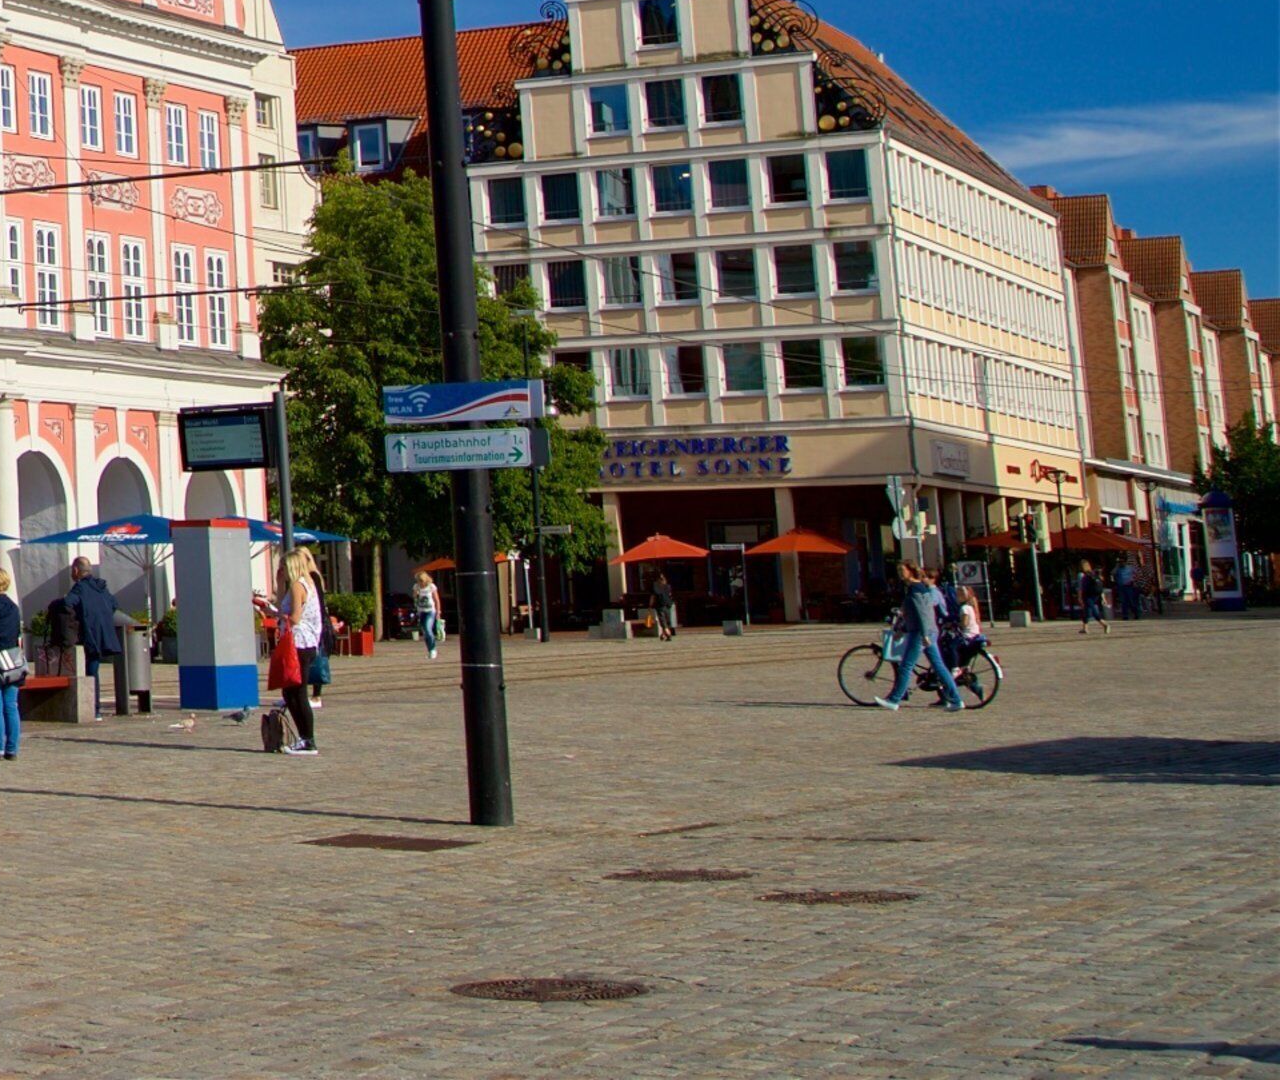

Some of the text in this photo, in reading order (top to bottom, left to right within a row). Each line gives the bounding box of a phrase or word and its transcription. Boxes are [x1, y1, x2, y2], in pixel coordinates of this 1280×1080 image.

[389, 406, 413, 415] WLAN
[412, 435, 492, 452] Hauptbahnhof
[603, 435, 791, 459] EIGENBERGER
[413, 451, 506, 465] Tourismusinformation
[696, 457, 792, 476] SONNE
